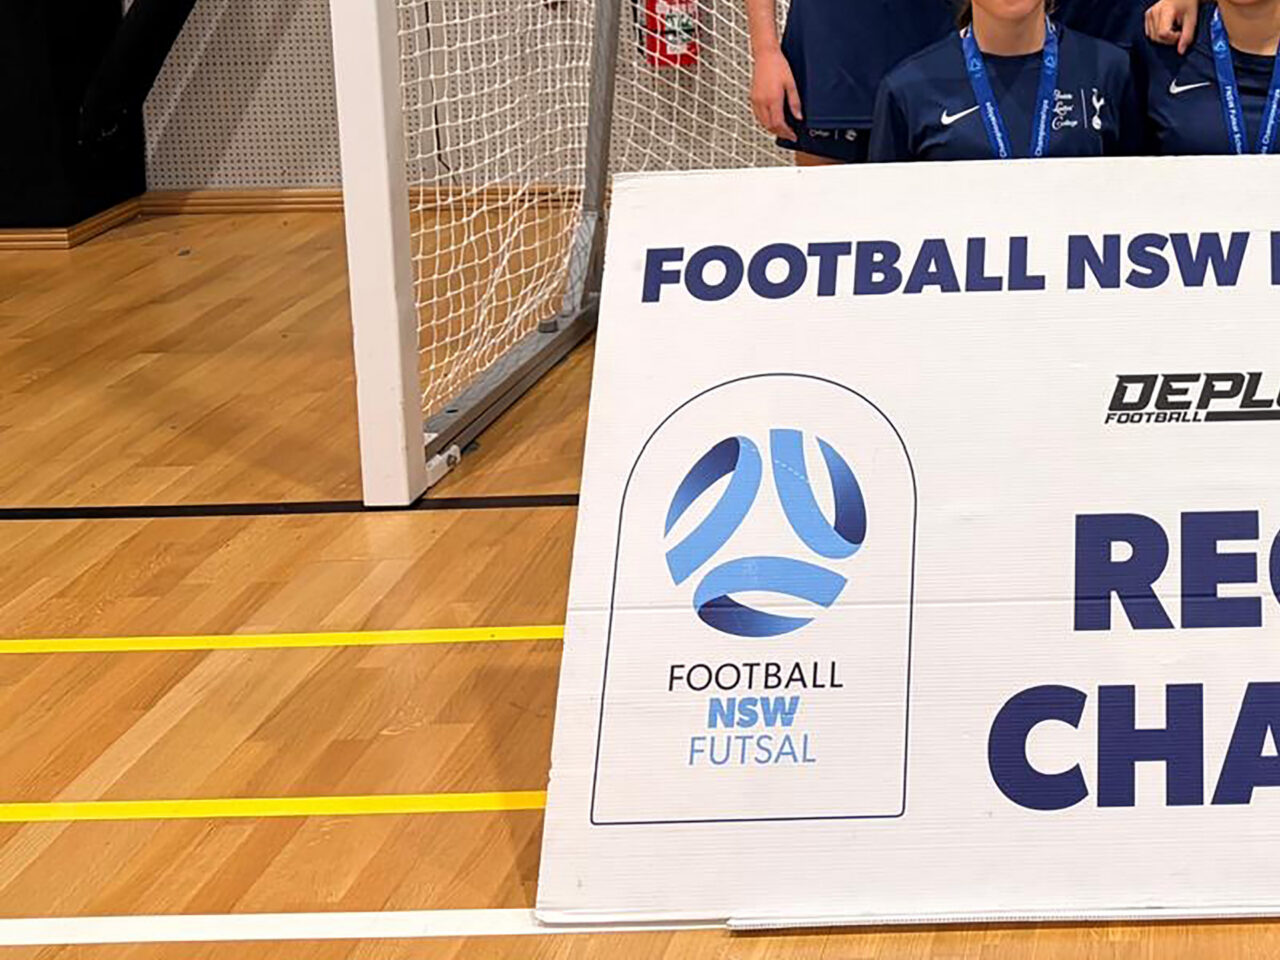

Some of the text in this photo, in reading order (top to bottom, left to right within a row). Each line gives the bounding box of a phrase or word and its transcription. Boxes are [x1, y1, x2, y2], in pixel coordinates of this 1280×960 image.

[642, 236, 1045, 303] FOOTBALL
[1067, 232, 1250, 289] NSW
[1104, 411, 1202, 424] FOOTBALL
[669, 661, 843, 691] FOOTBALL
[708, 695, 800, 728] NSW
[689, 734, 816, 765] FUTSAL
